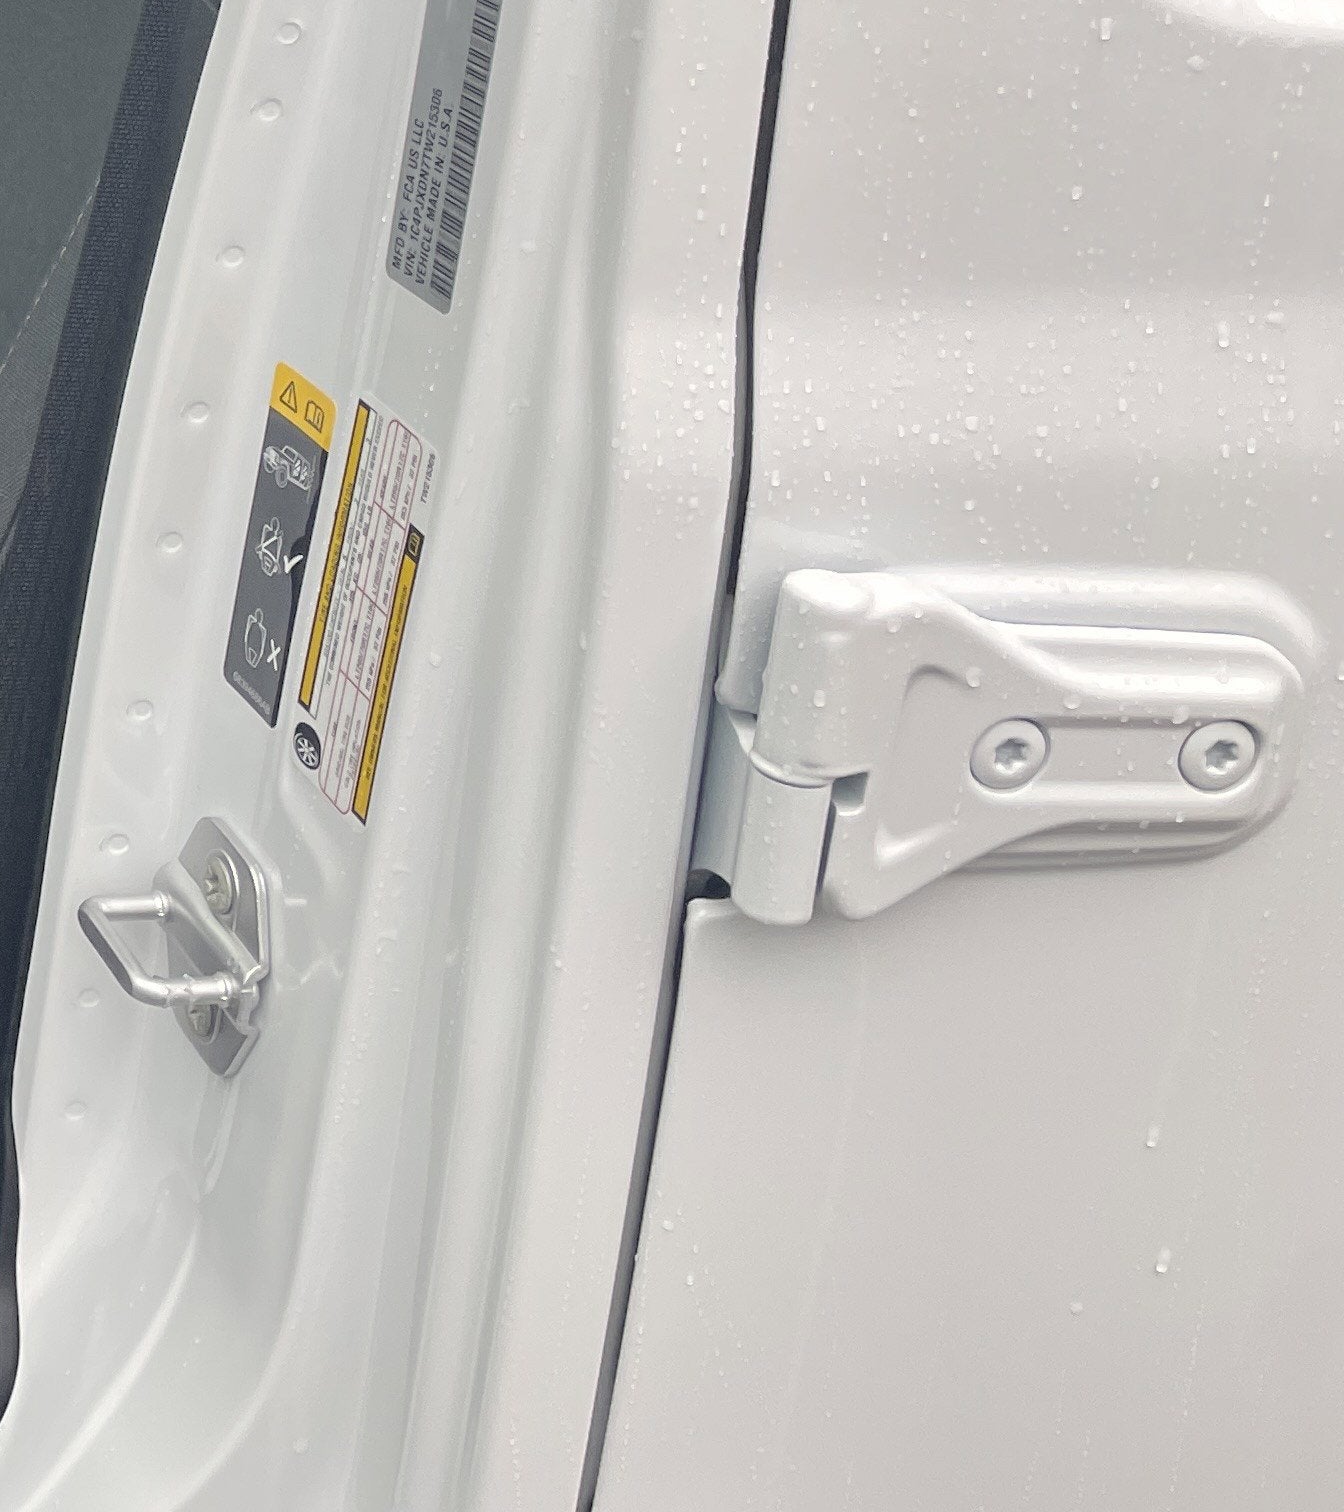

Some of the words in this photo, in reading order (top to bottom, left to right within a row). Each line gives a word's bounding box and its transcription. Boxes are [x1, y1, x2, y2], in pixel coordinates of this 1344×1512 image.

[412, 118, 424, 145] LLC
[408, 149, 419, 169] US
[402, 175, 414, 202] FCA
[415, 224, 433, 284] VEHICLE
[427, 177, 441, 221] MADE
[392, 237, 405, 269] MFD
[404, 250, 416, 276] VIN:
